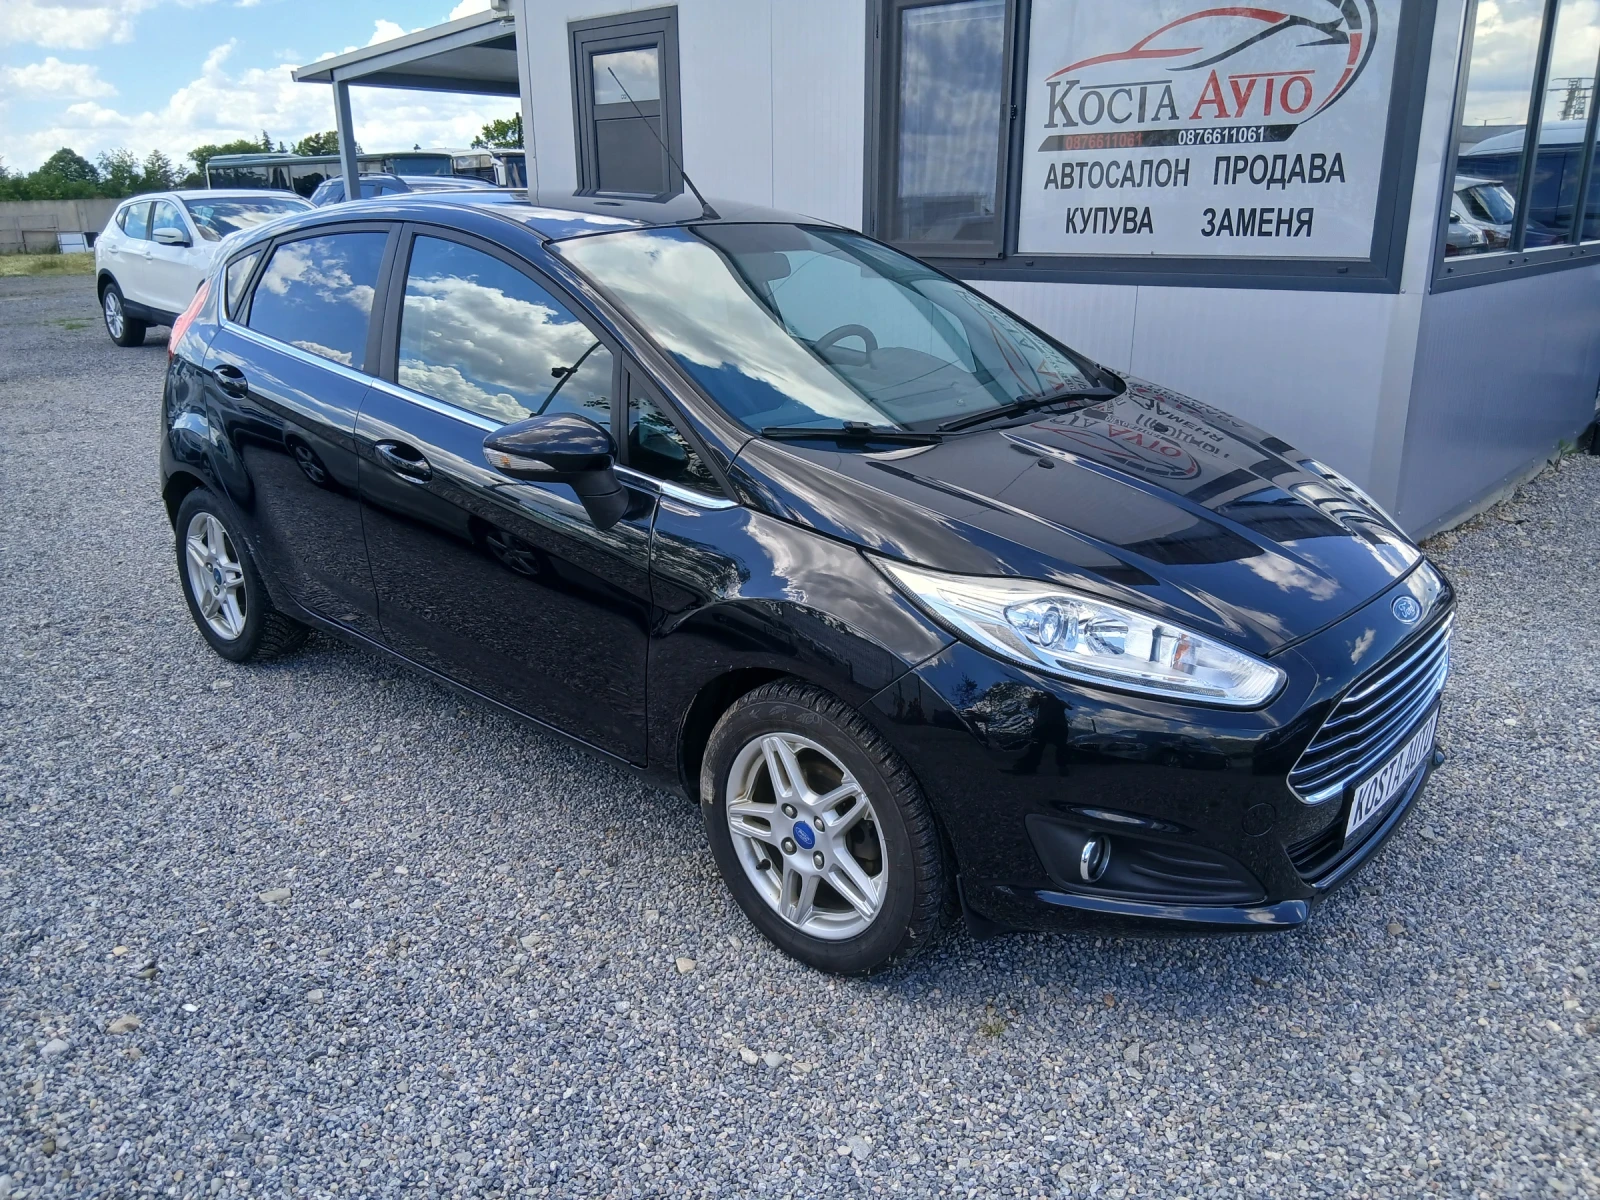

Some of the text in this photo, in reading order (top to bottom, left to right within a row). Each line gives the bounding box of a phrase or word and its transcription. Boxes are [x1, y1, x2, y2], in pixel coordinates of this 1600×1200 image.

[1065, 127, 1265, 150] 0876611061 0876611061
[1044, 152, 1346, 190] АВТОСАЛОН ПРОДАВА
[1065, 207, 1314, 237] КУПУВА ЗАМЕНЯ
[1352, 750, 1405, 827] KOSTA
